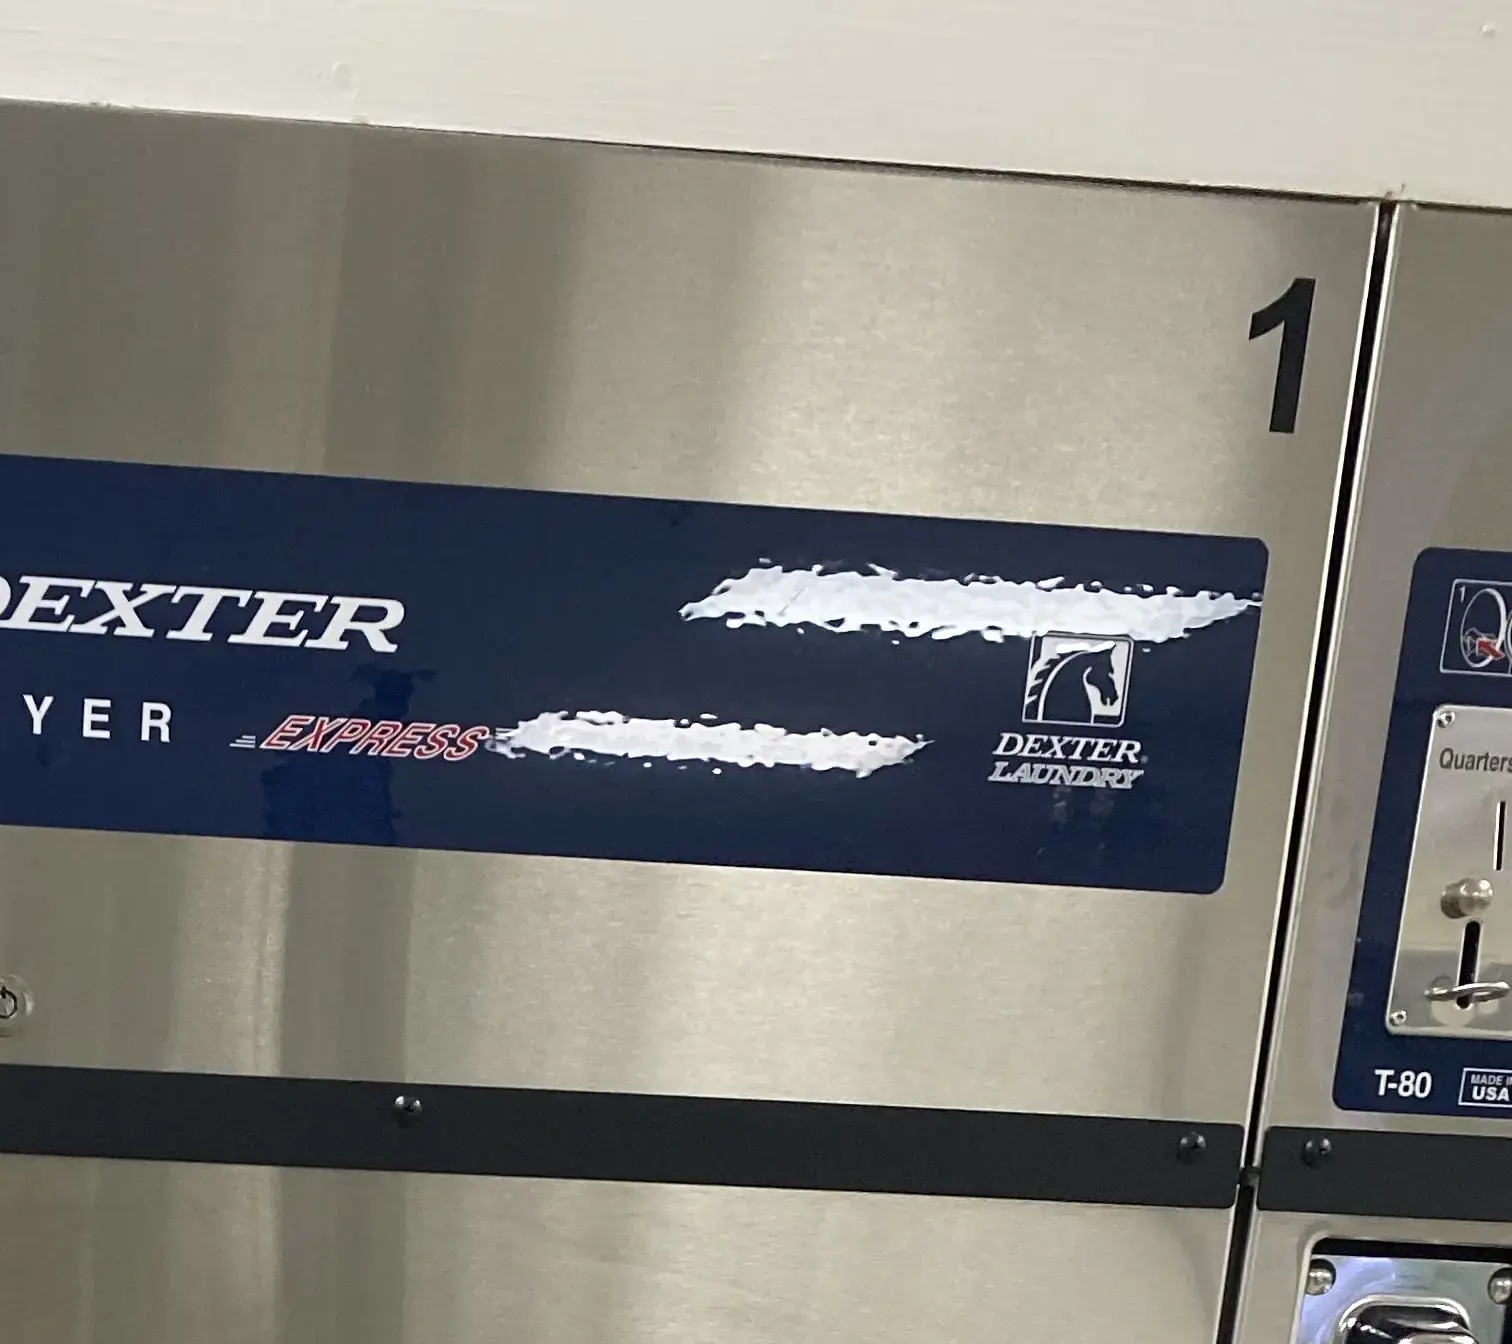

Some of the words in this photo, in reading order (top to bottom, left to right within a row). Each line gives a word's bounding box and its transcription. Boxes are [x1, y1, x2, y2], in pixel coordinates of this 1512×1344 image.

[1249, 278, 1316, 434] 1
[260, 715, 491, 761] EXPRESS
[992, 732, 1141, 763] DEXTER
[988, 761, 1145, 789] LAUNDRY
[1374, 1069, 1432, 1098] T-80
[1471, 1074, 1503, 1086] MADE
[1472, 1086, 1509, 1101] USA
